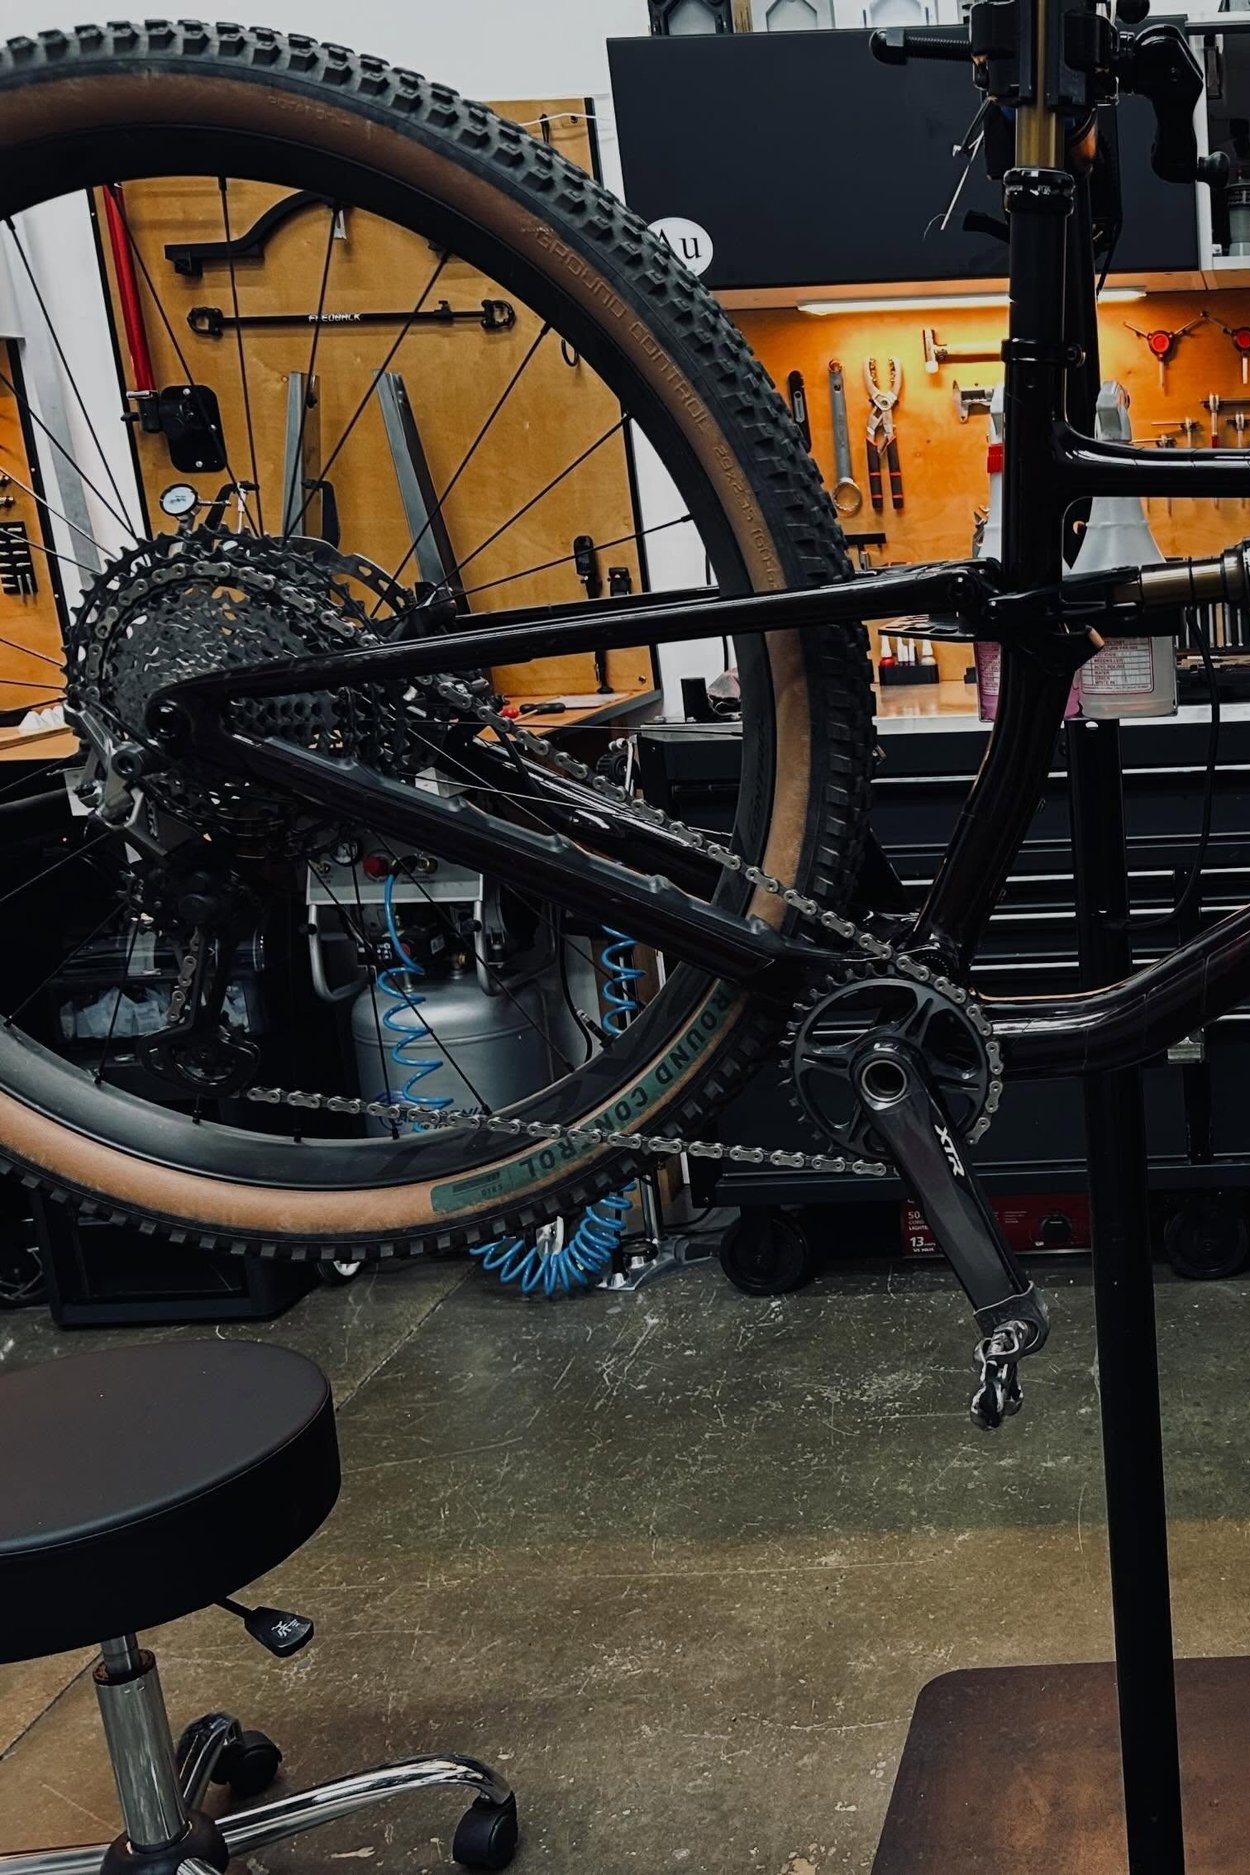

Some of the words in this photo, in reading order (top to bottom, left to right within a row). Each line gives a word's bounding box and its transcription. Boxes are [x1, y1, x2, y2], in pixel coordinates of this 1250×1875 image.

[629, 321, 708, 427] CONTROL
[519, 1086, 648, 1179] CONROL
[934, 1124, 965, 1176] XTR
[910, 1236, 925, 1247] 13
